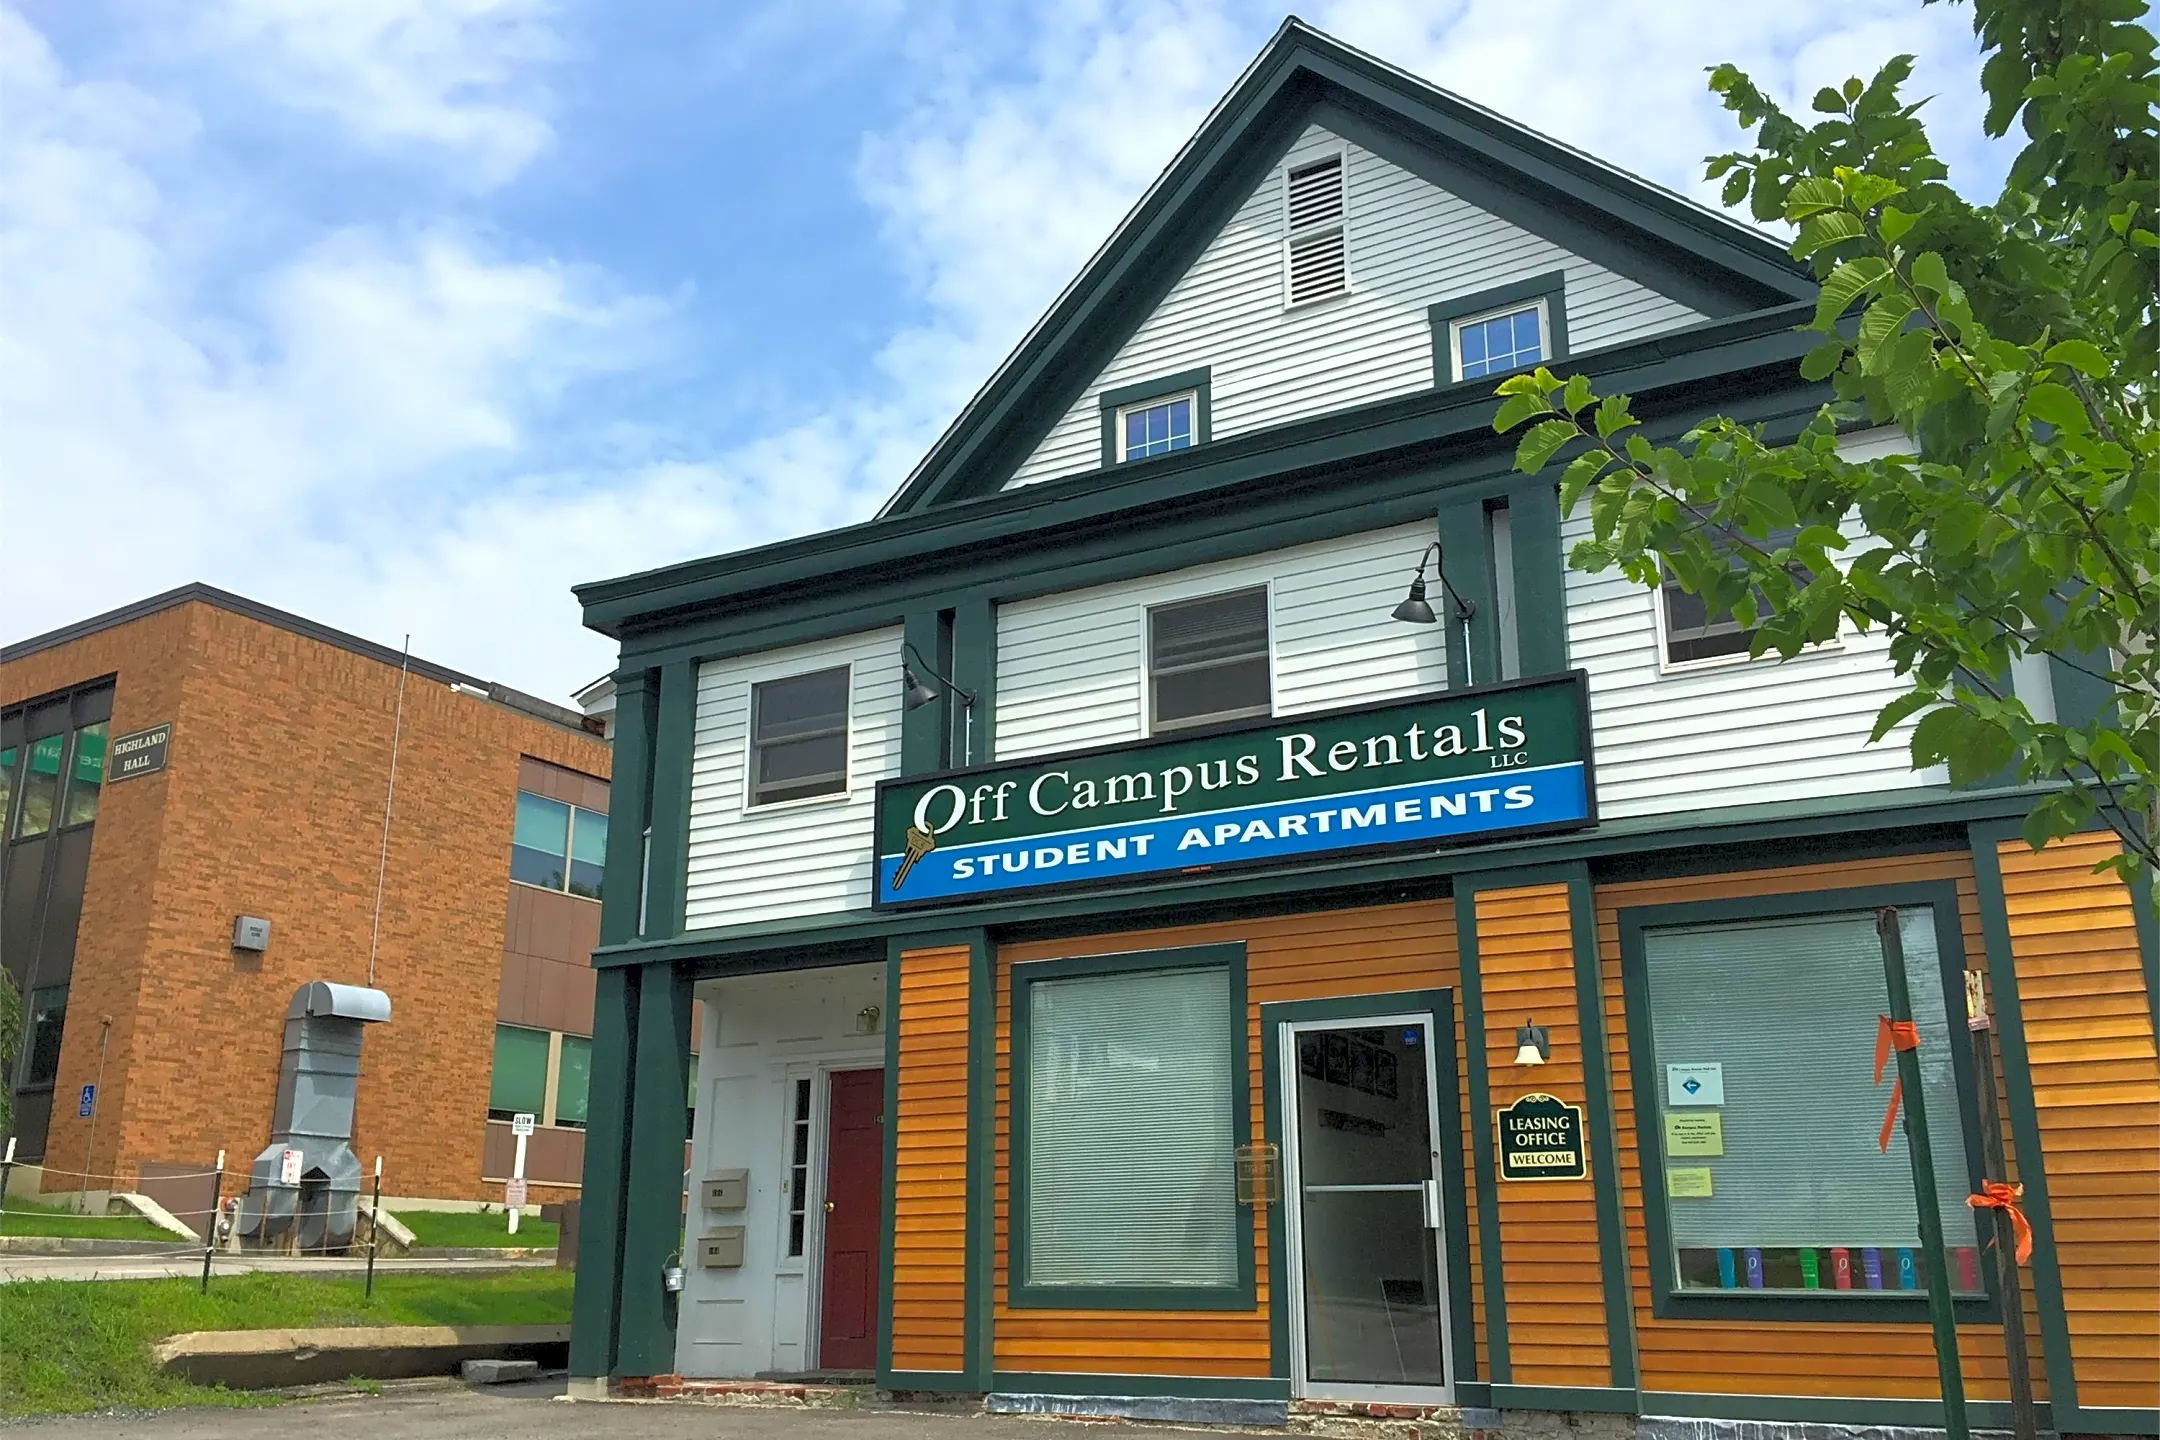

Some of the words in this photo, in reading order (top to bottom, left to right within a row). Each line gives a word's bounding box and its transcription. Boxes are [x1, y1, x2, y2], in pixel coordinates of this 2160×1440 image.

[114, 732, 166, 755] HIGHLAND
[123, 755, 150, 771] HALL
[1490, 752, 1527, 768] LLC
[914, 781, 1017, 834] Off
[1029, 755, 1259, 815] Campus
[1276, 708, 1525, 781] Rentals
[953, 834, 1154, 879] STUDENT
[1177, 785, 1534, 850] APARTMENTS
[515, 1116, 532, 1125] SLOW
[1509, 1116, 1570, 1130] LEASING
[1515, 1132, 1567, 1146] OFFICE
[1513, 1154, 1572, 1164] WELCOME
